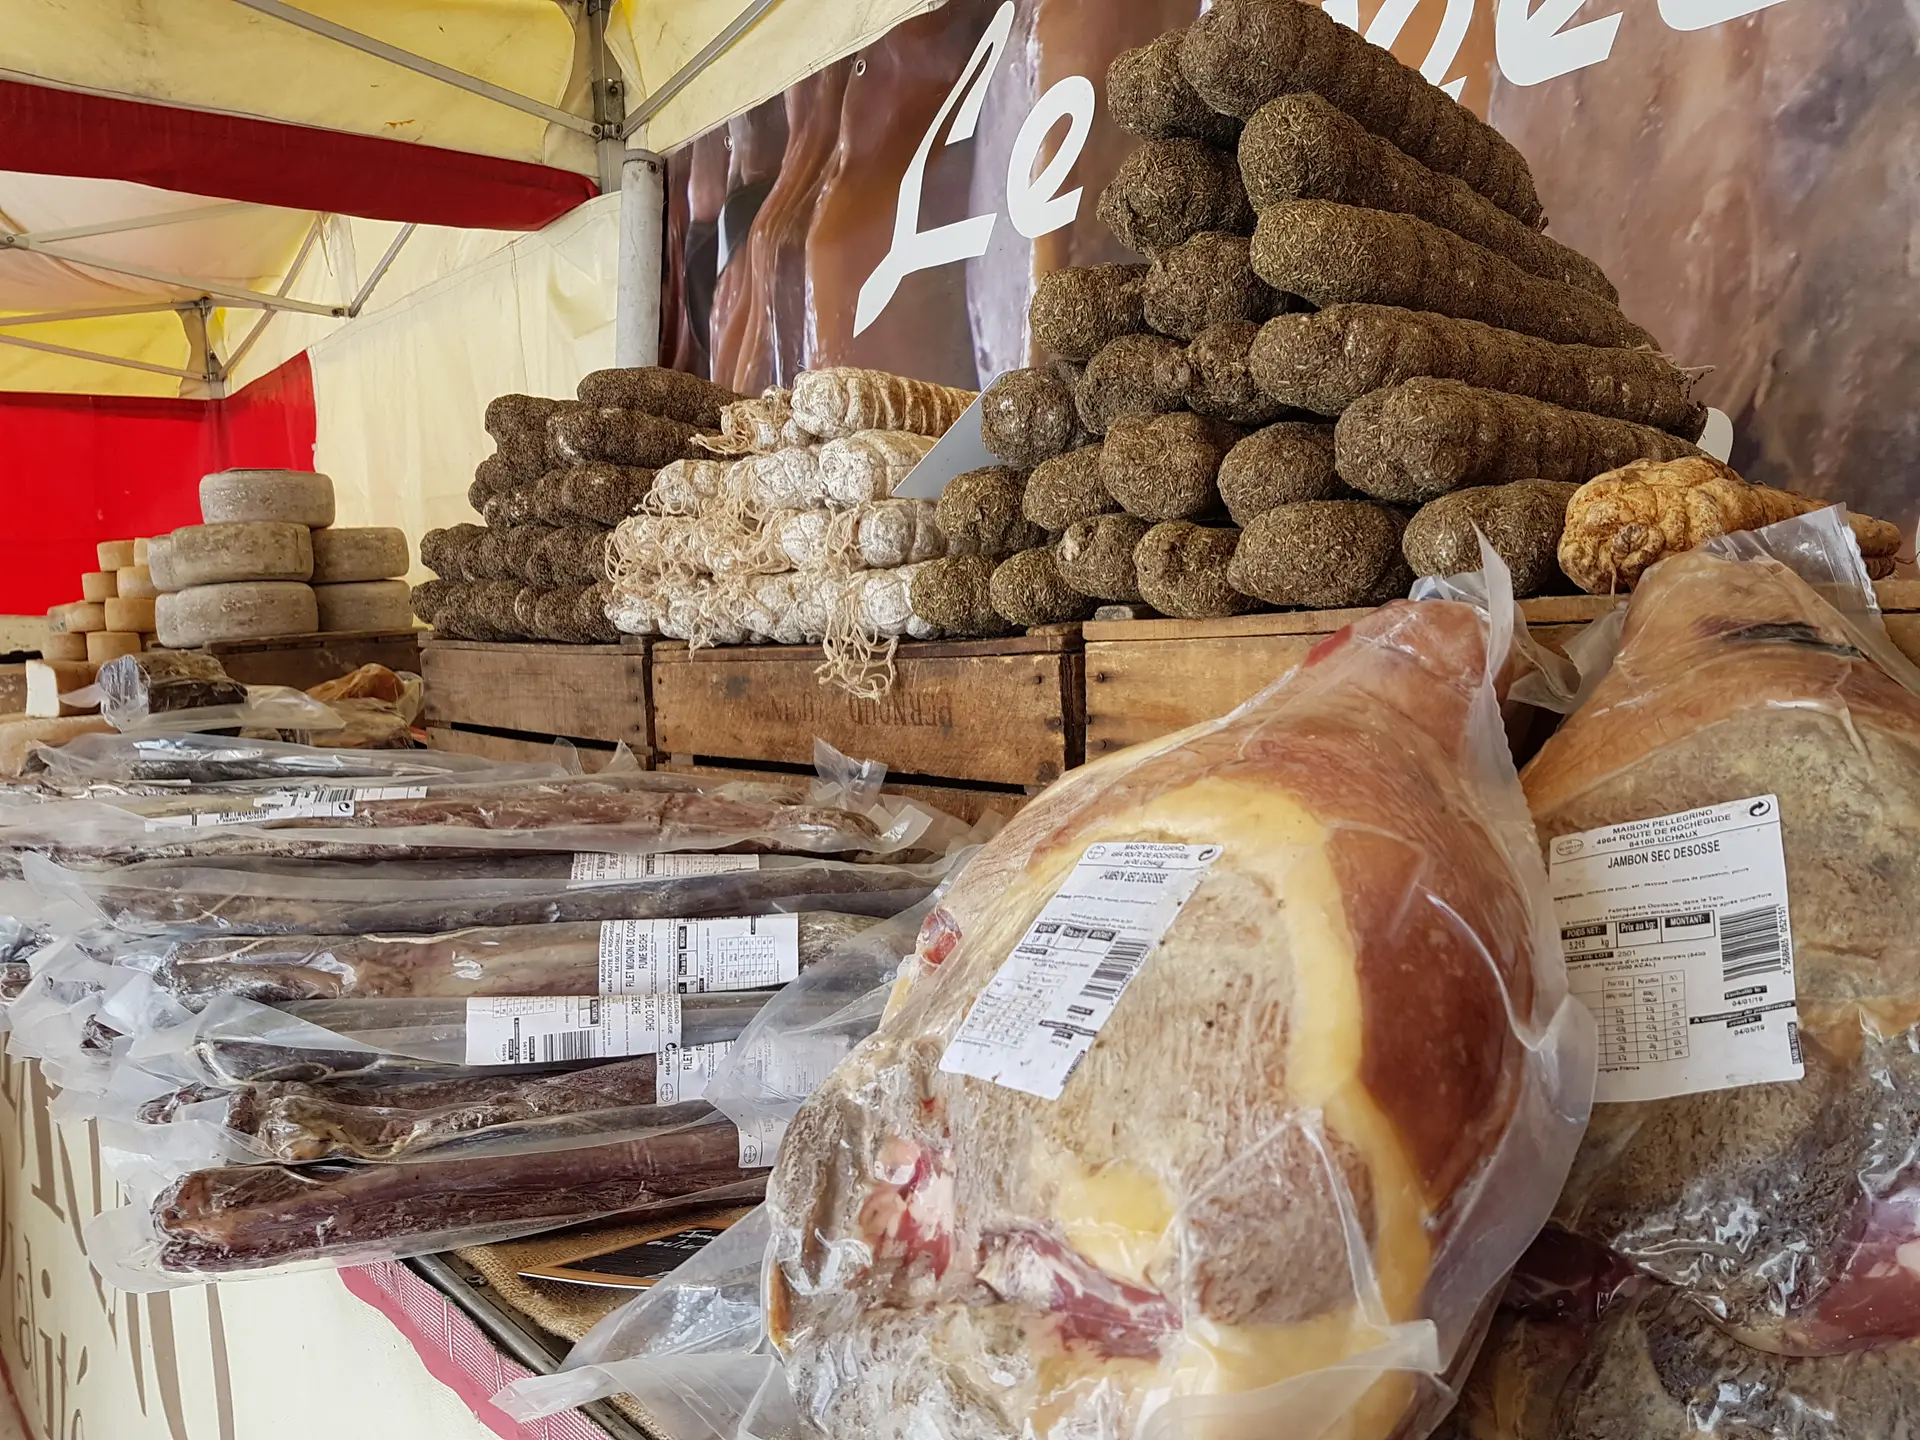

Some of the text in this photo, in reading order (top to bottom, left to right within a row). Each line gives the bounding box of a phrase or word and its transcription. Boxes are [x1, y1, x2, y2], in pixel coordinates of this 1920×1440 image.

[853, 0, 1096, 339] Le
[1612, 808, 1713, 835] MAISON PELLEGRINO
[1618, 829, 1652, 843] ROUTE
[1653, 826, 1668, 836] DE
[1669, 813, 1732, 833] ROCHEGUDE
[1628, 830, 1699, 849] 84100 UCHAUX
[1607, 839, 1721, 869] JAMBON SEC DESOSSE
[626, 920, 637, 939] COCHE
[1620, 920, 1657, 933] Prix au kg:
[1670, 914, 1706, 927] MONTANT:
[626, 938, 636, 946] DE
[638, 933, 648, 970] FUME SECHE
[1600, 938, 1610, 948] kg
[600, 924, 609, 983] MAISON PELLEGRINO
[607, 949, 614, 959] DE
[625, 946, 635, 970] MIGNON
[625, 971, 635, 988] FILET
[645, 1000, 655, 1009] DE
[645, 1009, 655, 1032] COCHE
[683, 1053, 693, 1071] FILET
